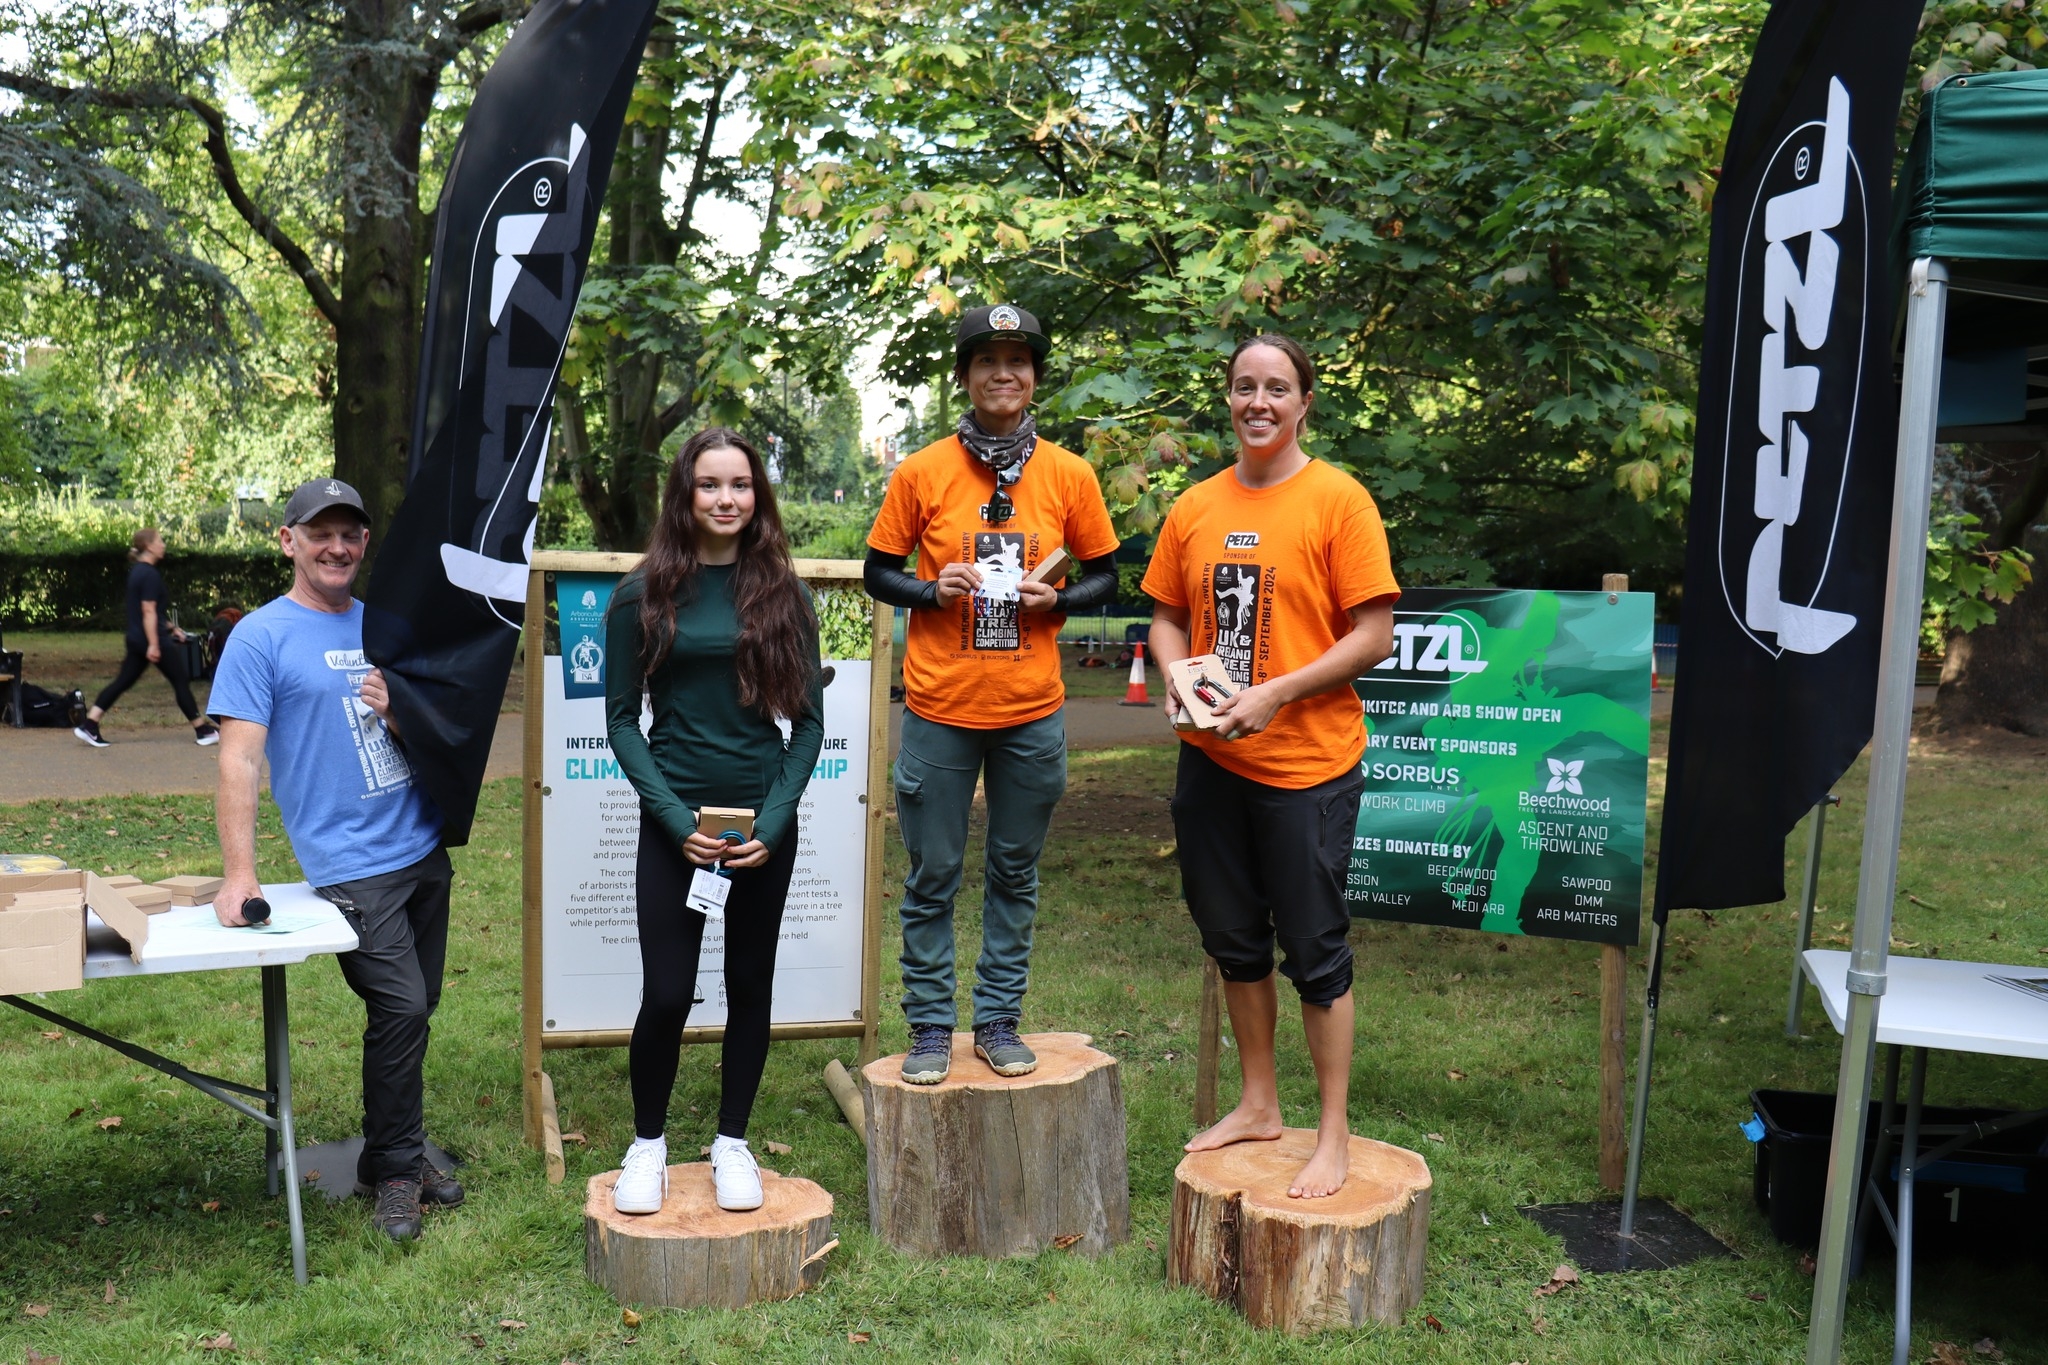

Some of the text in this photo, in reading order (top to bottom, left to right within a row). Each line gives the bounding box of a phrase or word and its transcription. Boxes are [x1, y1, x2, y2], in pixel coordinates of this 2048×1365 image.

[1029, 533, 1039, 558] 2024
[1225, 535, 1260, 550] PETZL
[1202, 562, 1211, 605] COVENTRY
[1263, 566, 1277, 594] 2024
[976, 618, 1016, 628] TREE
[1259, 597, 1272, 661] SEPTEMBER
[976, 628, 1018, 638] CLIMBING
[1218, 629, 1252, 648] UK &
[975, 639, 1018, 648] COMPETITION
[1221, 658, 1250, 671] REE
[1409, 703, 1438, 717] AND
[1443, 704, 1471, 718] ARB
[1476, 706, 1518, 721] SHOW
[1523, 708, 1561, 723] OPEN
[1393, 736, 1437, 751] EVENT
[1441, 739, 1517, 756] SPONSORS
[1373, 763, 1459, 785] SORBUS
[600, 801, 609, 809] to
[1361, 795, 1445, 814] WORK CLIMB
[1518, 791, 1610, 812] Beechwood
[601, 813, 613, 821] for
[1549, 809, 1594, 817] LANDSCAPES
[1518, 820, 1608, 840] ASCENT AND
[600, 839, 636, 847] between
[1385, 839, 1448, 857] DONATED
[1453, 844, 1471, 859] BY
[1521, 836, 1604, 856] THROWLINE
[593, 851, 609, 859] and
[600, 869, 616, 877] The
[1427, 864, 1497, 881] BEECHWOOD
[579, 881, 588, 890] of
[590, 881, 628, 890] arborists
[798, 878, 830, 887] perform
[1441, 882, 1487, 897] SORBUS
[570, 894, 586, 902] five
[588, 894, 624, 902] different
[811, 890, 831, 898] tests
[1372, 892, 1410, 905] VALLEY
[1451, 900, 1504, 915] MEDI ARB
[570, 919, 593, 927] while
[1537, 908, 1617, 927] ARB MATTERS
[601, 936, 619, 944] Tree
[791, 932, 809, 940] held
[1944, 1187, 1960, 1223] 1
